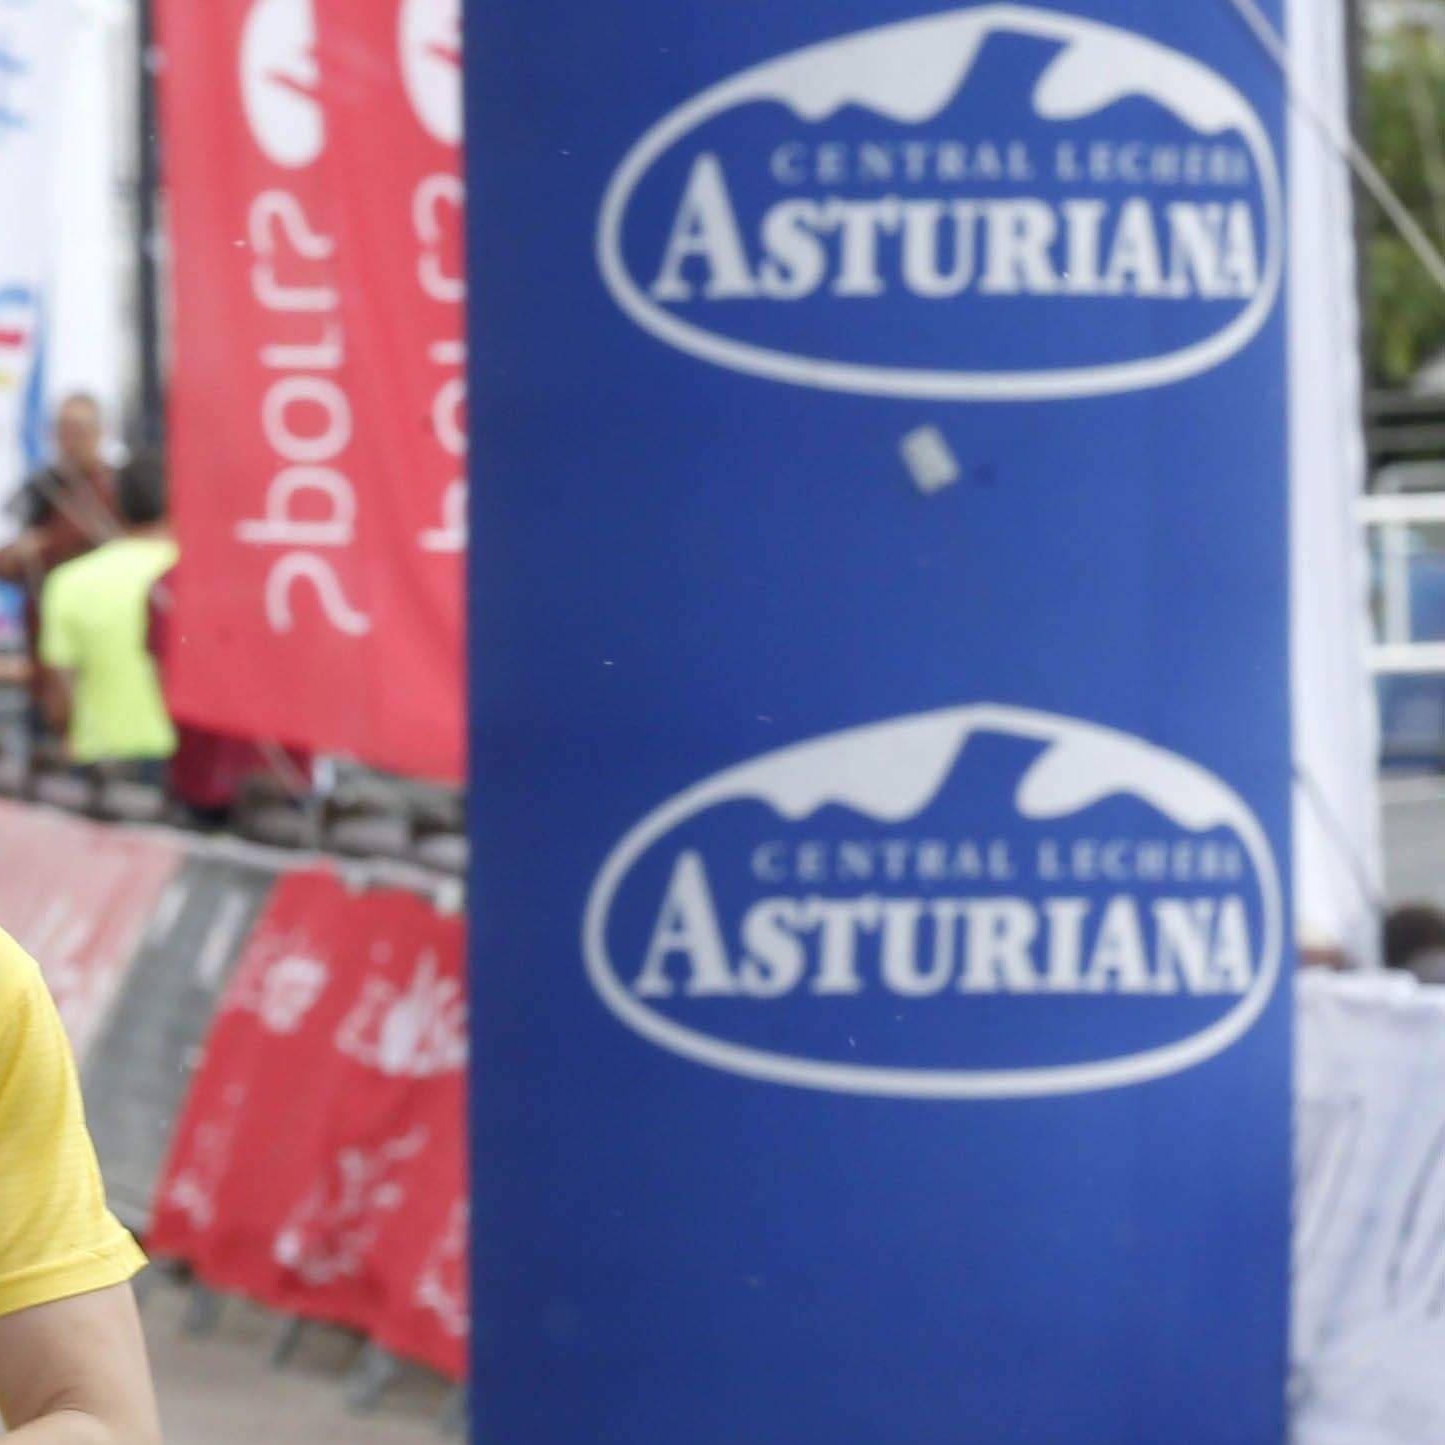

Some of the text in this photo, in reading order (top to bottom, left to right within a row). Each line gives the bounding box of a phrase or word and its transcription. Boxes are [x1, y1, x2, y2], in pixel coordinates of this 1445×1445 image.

[770, 140, 1035, 184] CENTRAL
[651, 153, 1260, 301] ASTURIANA
[751, 839, 1017, 883] CENTRAL
[635, 849, 1252, 998] ASTURIANA
